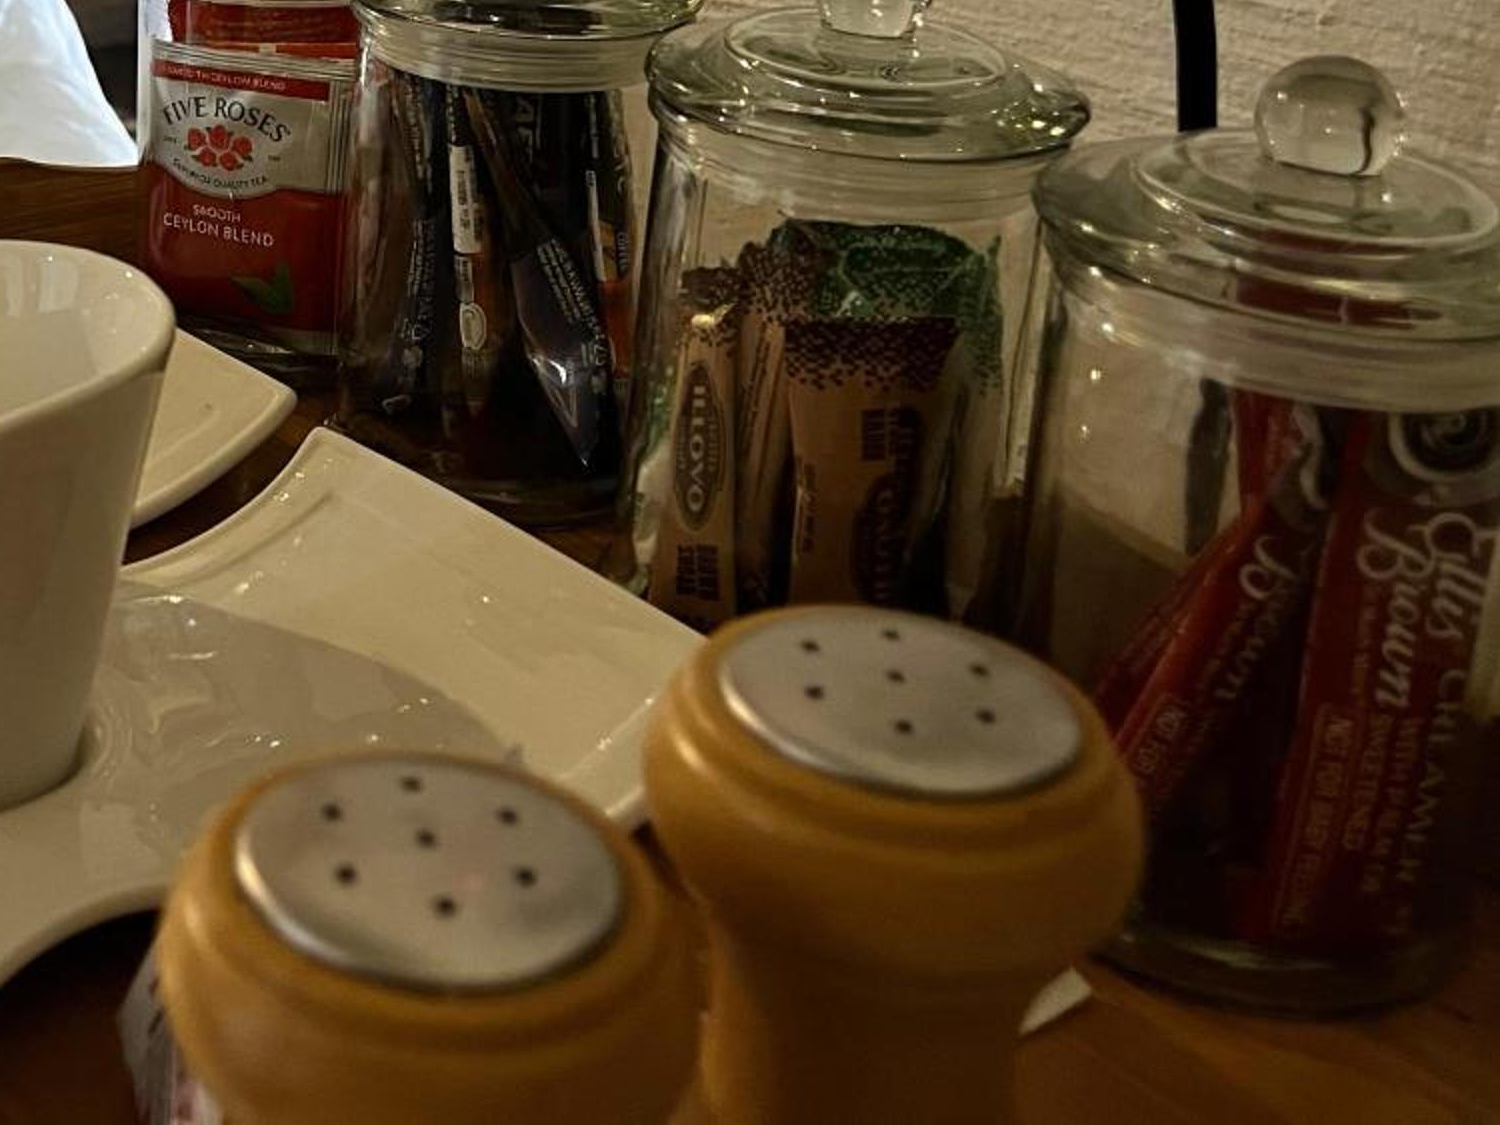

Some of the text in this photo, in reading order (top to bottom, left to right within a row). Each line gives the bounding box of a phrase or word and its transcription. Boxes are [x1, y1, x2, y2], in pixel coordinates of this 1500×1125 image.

[163, 96, 289, 142] FIVE ROSES
[251, 176, 268, 186] TEA
[163, 213, 275, 247] CEYLON BLEND
[192, 204, 241, 222] SMOOTH
[686, 384, 707, 514] ILLOVO
[1422, 512, 1495, 640] Ellis
[1356, 509, 1436, 710] Brown
